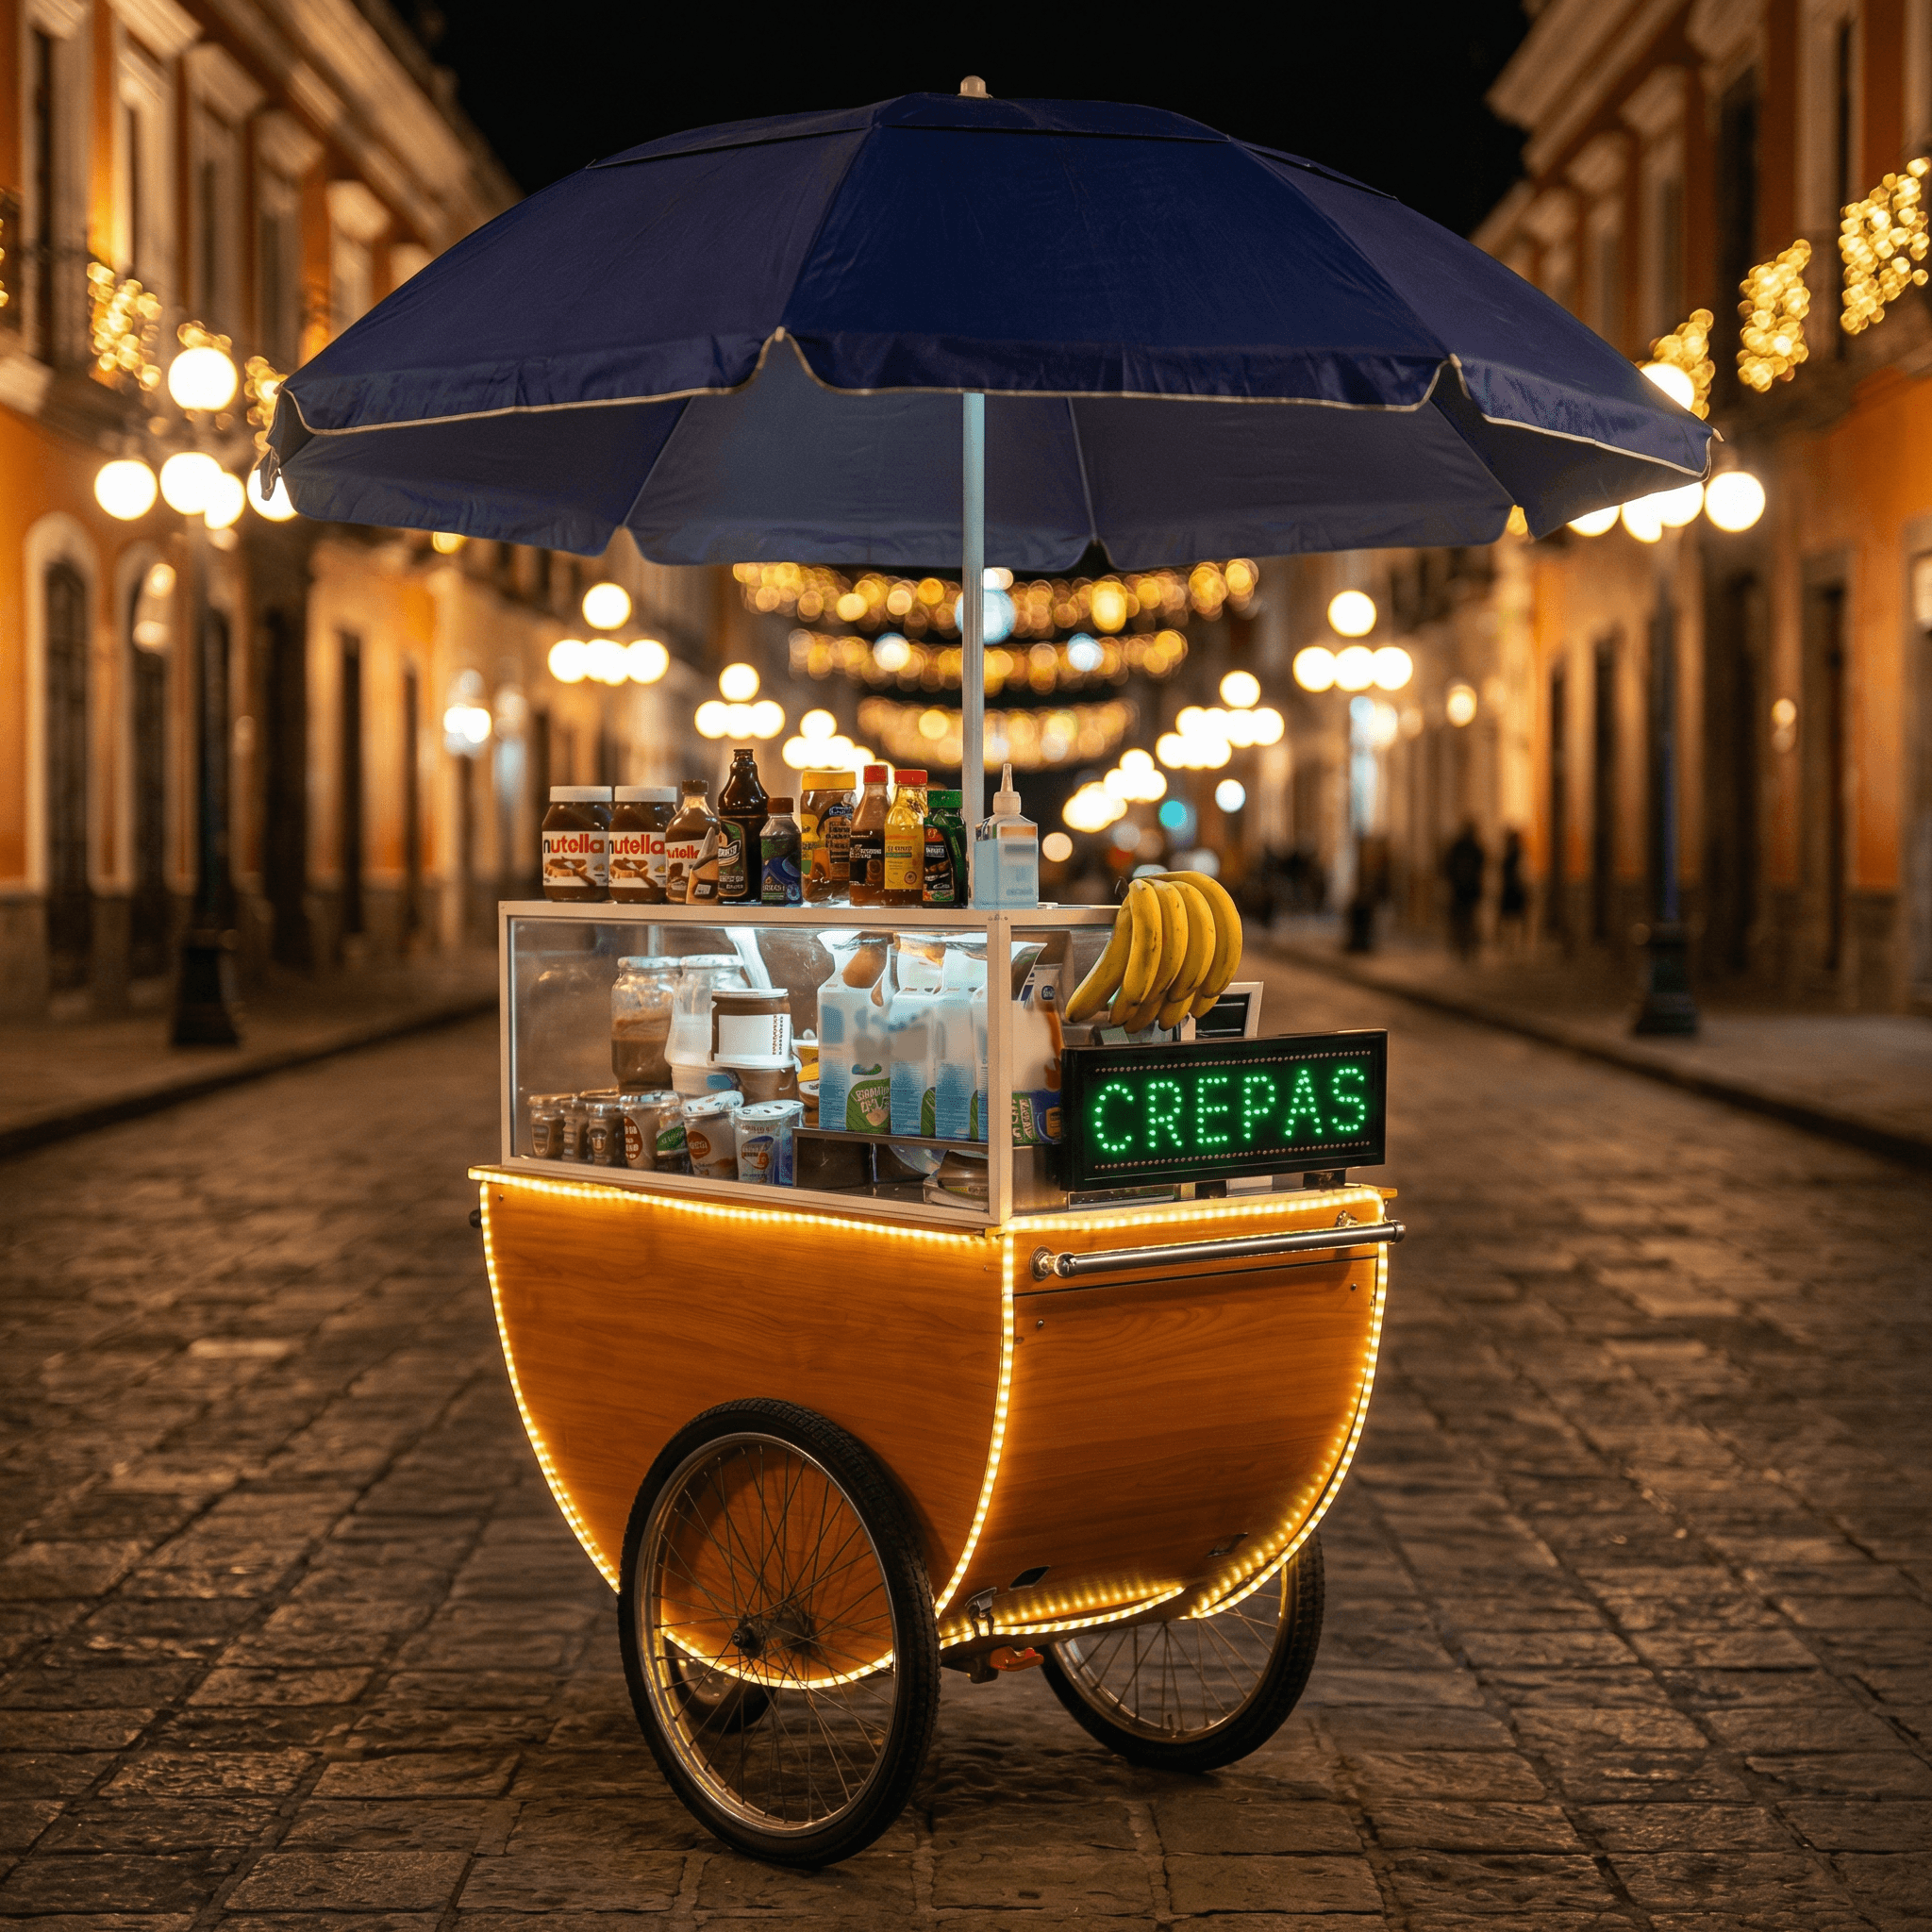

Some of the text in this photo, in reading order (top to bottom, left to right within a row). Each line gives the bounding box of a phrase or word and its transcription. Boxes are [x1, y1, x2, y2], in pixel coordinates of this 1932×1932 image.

[543, 833, 605, 854] nutella
[609, 834, 665, 855] nutella
[1093, 1067, 1367, 1152] CREPAS
